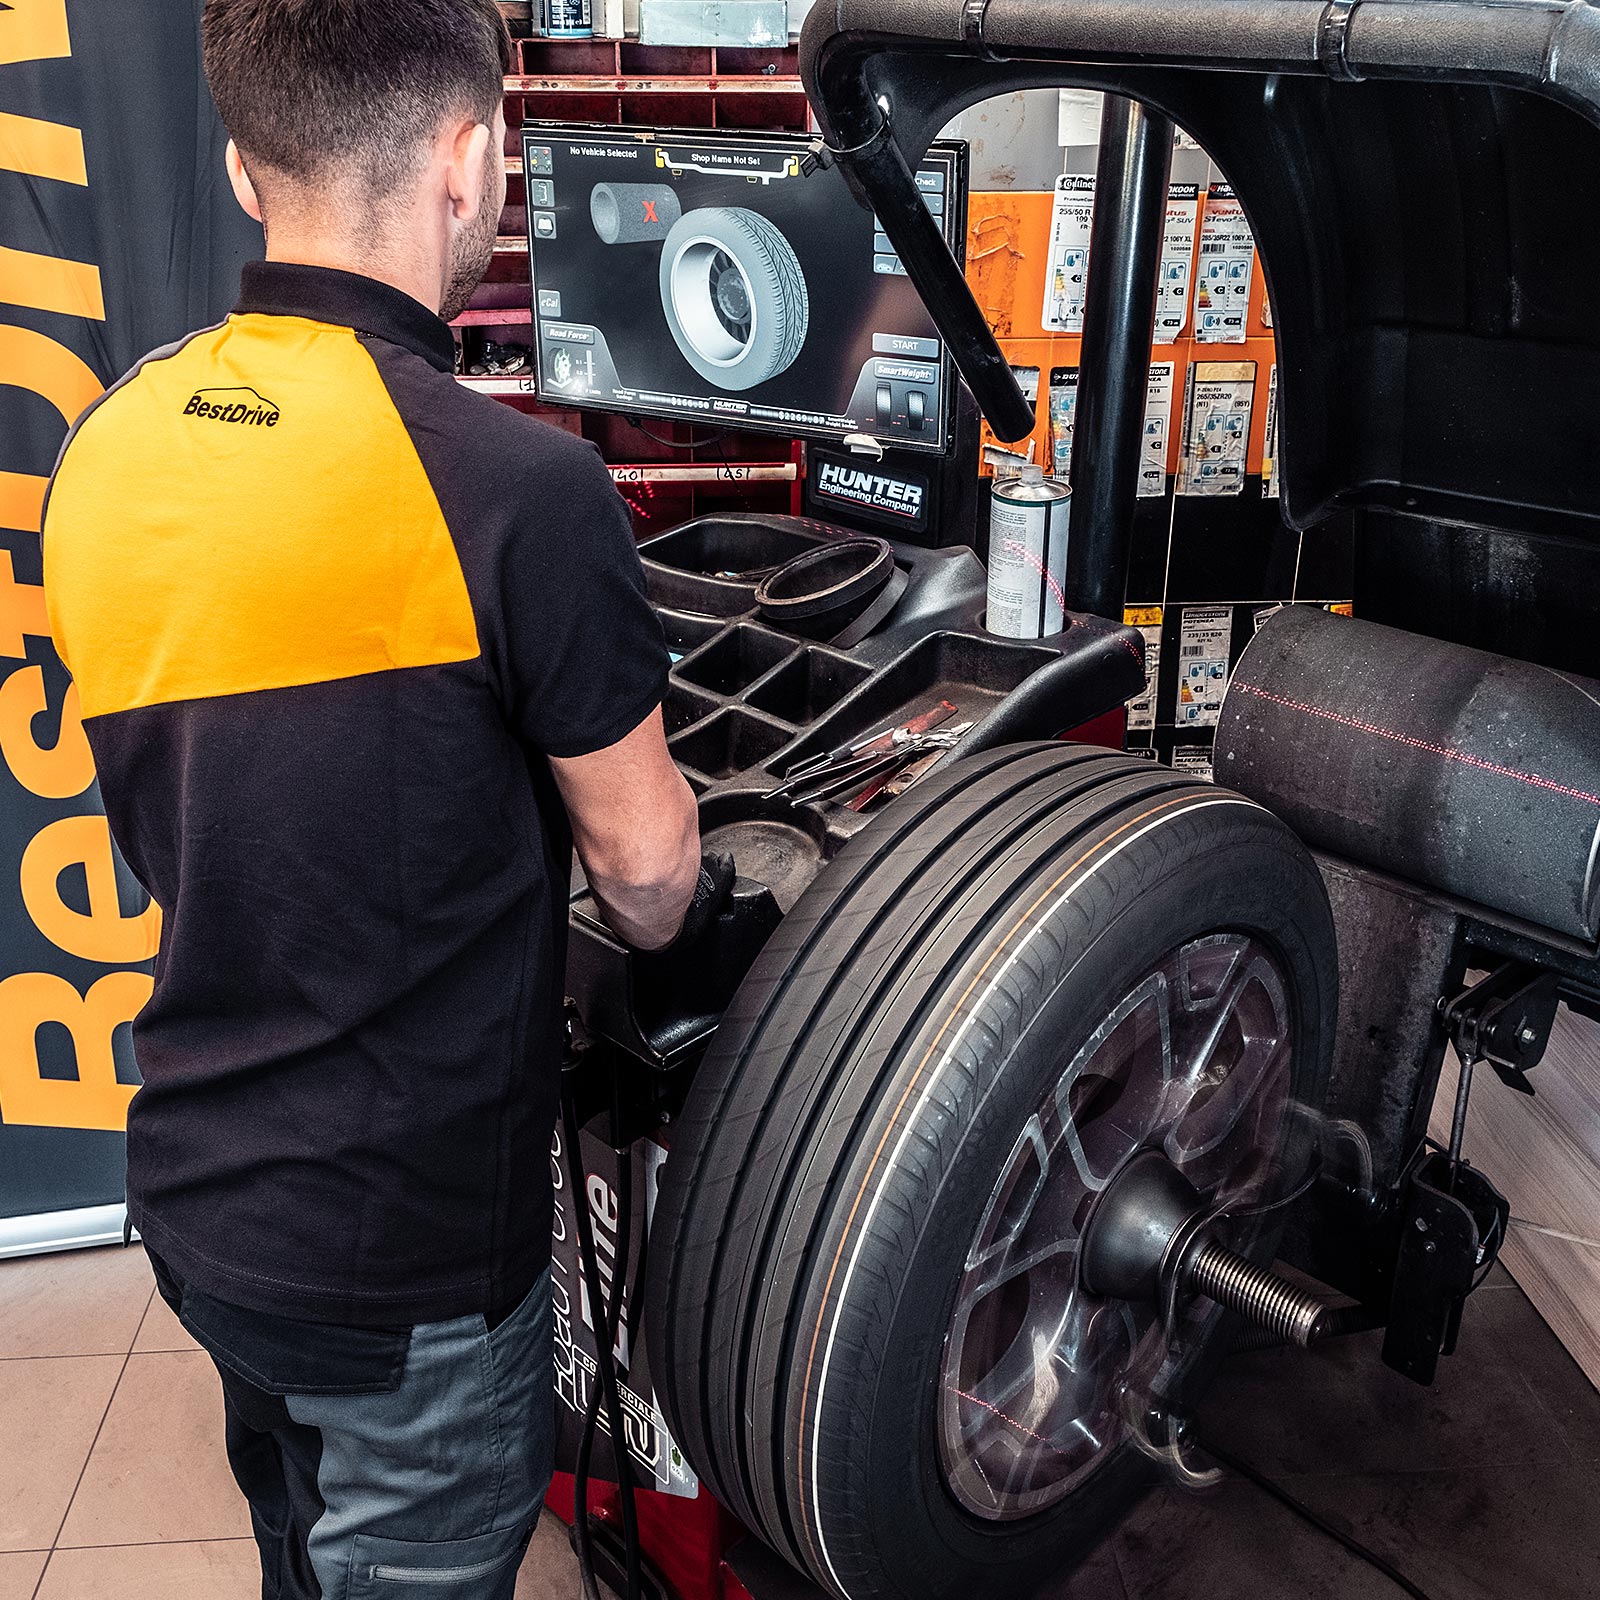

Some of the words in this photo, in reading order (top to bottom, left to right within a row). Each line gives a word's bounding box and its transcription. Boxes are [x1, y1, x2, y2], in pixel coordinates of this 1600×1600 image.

[570, 147, 580, 155] No
[581, 147, 606, 157] Vehicle
[607, 149, 638, 158] Selected
[691, 153, 711, 164] Shop
[711, 154, 732, 164] Name
[733, 156, 747, 165] Not
[747, 156, 761, 165] Set
[914, 178, 937, 186] Check
[541, 298, 558, 308] eCal
[549, 329, 567, 337] Road
[892, 340, 918, 350] START
[878, 365, 930, 379] SmartWeight
[182, 395, 280, 427] BestDrive
[820, 463, 922, 504] HUNTER
[819, 480, 871, 503] Engineering
[873, 494, 919, 515] Company
